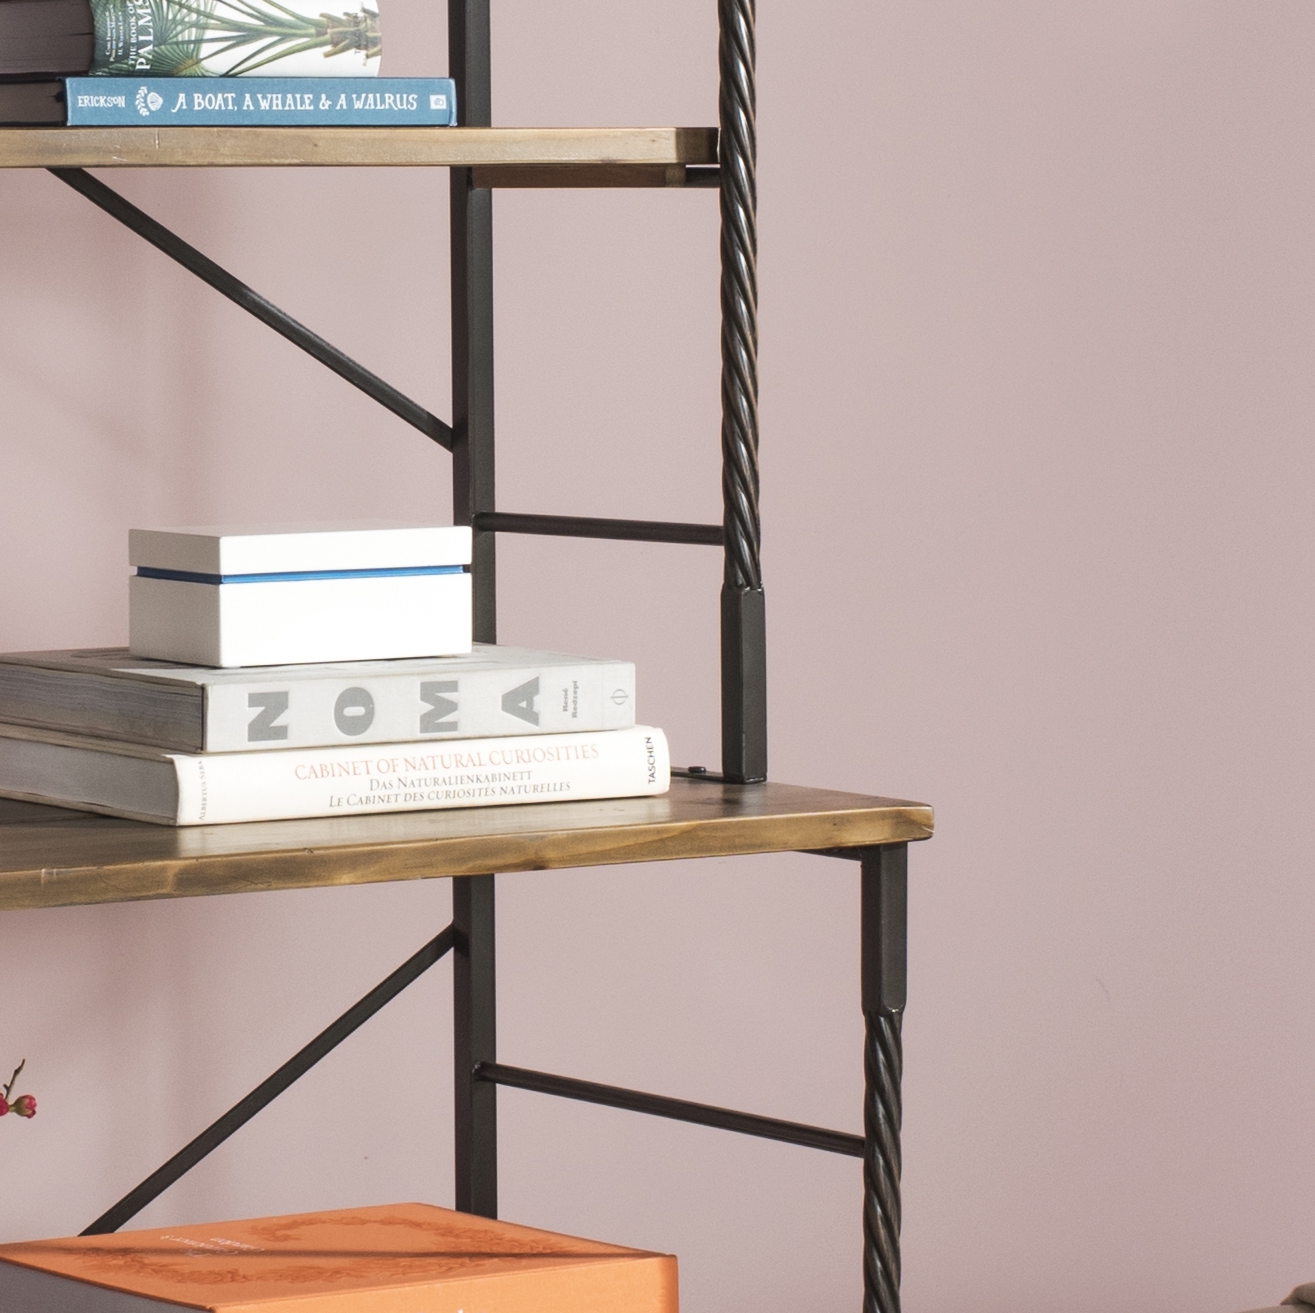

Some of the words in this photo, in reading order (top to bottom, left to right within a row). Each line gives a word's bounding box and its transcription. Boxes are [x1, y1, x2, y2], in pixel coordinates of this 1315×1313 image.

[128, 45, 137, 65] THE
[77, 95, 126, 108] ERICKSON
[171, 93, 187, 113] A
[193, 93, 238, 111] BOAT,
[242, 93, 255, 110] A
[257, 93, 314, 110] WHALE
[319, 93, 333, 110] &
[335, 93, 348, 110] A
[352, 93, 419, 111] WALRUS
[295, 759, 373, 780] CABINET
[376, 757, 400, 774] OF
[403, 751, 487, 772] NATURAL
[489, 743, 600, 766] CURIOSITIES
[644, 736, 656, 785] TASCHEN
[346, 792, 401, 806] CABINET
[403, 790, 425, 803] DES
[499, 781, 572, 796] NATURELLES
